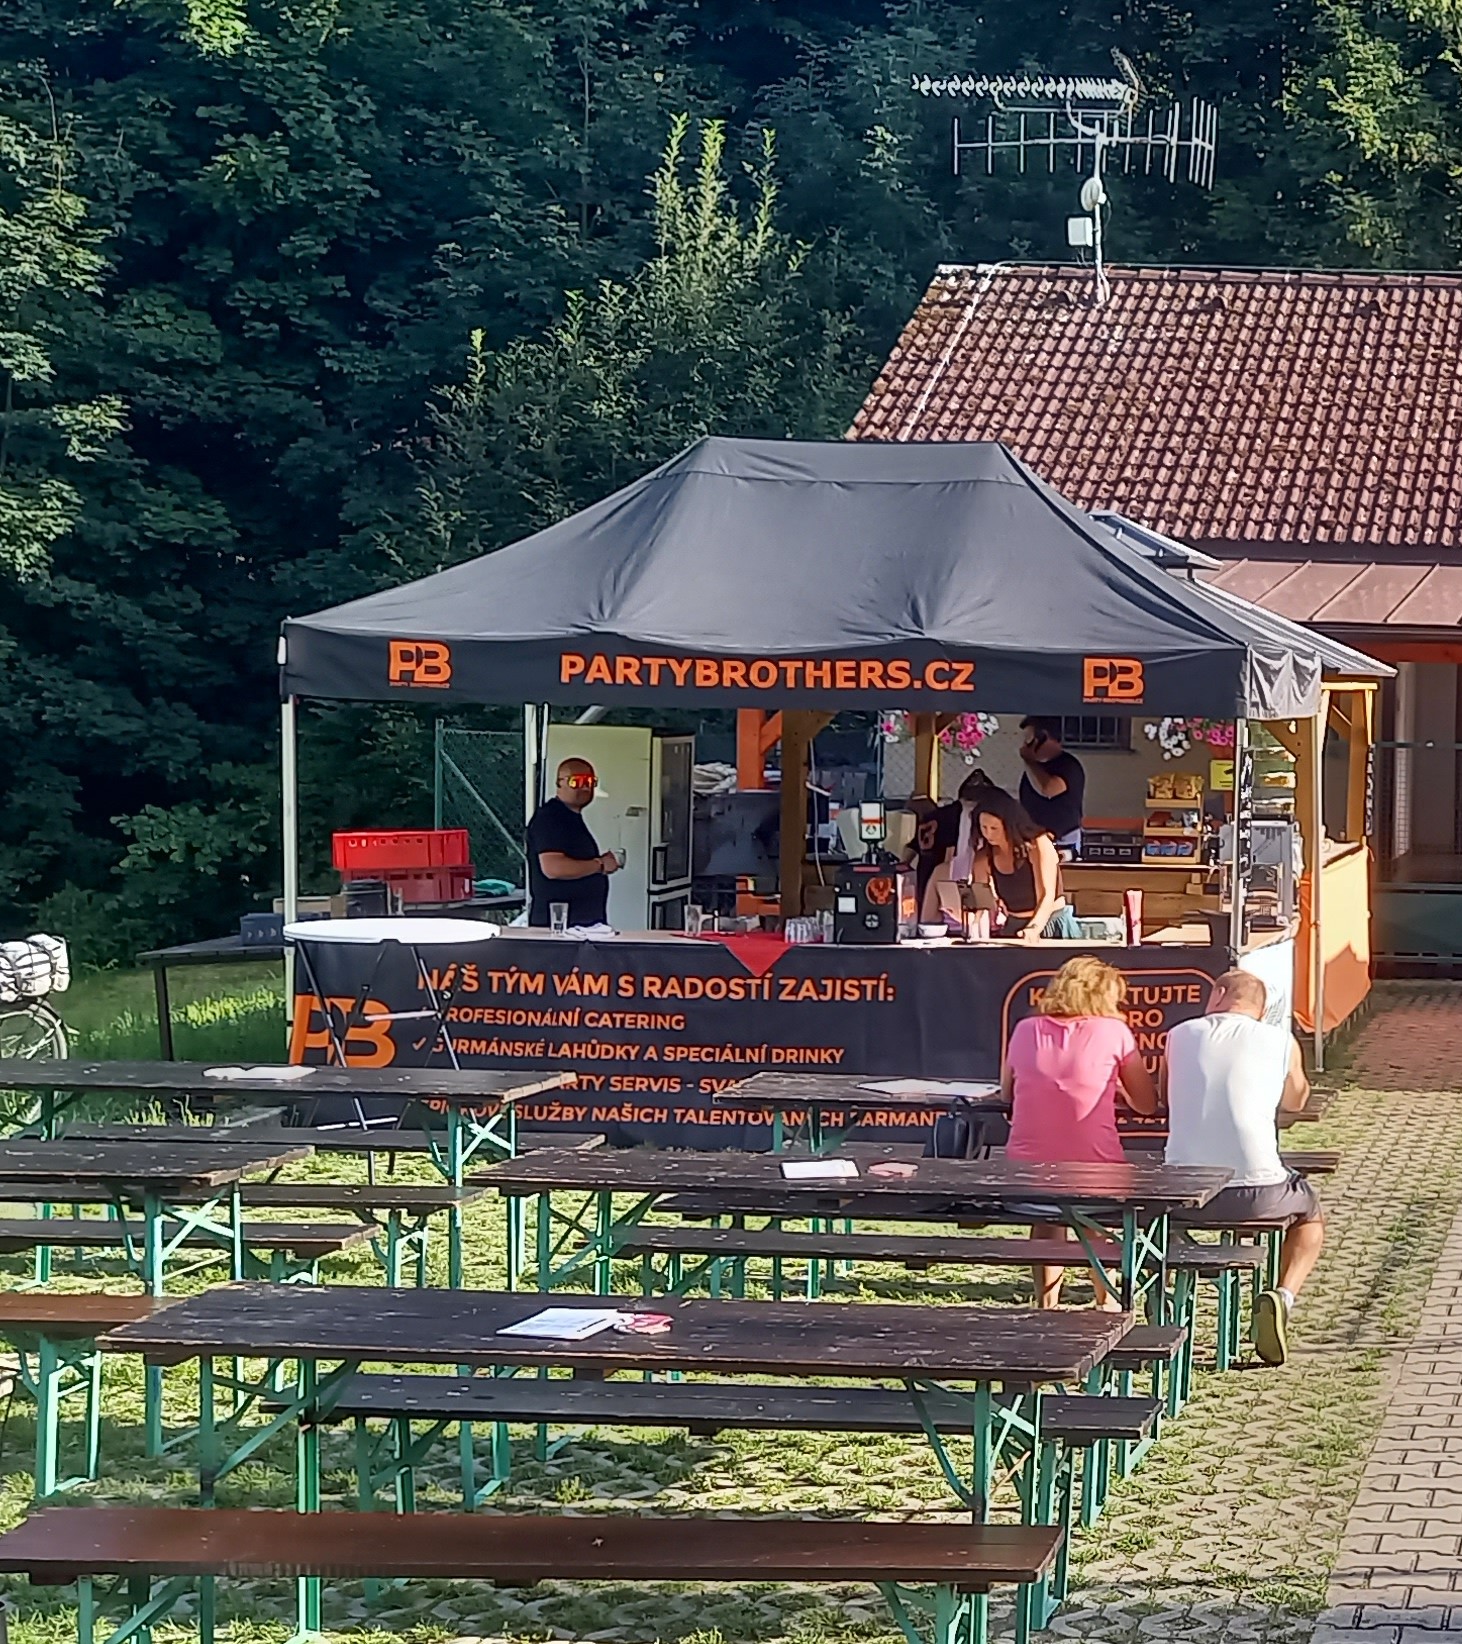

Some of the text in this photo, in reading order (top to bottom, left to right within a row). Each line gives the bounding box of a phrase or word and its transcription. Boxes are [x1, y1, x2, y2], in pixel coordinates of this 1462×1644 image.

[389, 641, 451, 682] PB
[560, 654, 975, 691] PARTYBROTHERS.CZ
[1083, 658, 1144, 698] PB
[418, 964, 895, 1001] NÁŠ TÝM VÁM S RADOSTÍ ZAJISTÍ:
[440, 1007, 685, 1030] ROFESIONÁLNÍ CATERING
[1122, 1009, 1163, 1028] RO
[549, 1039, 640, 1061] LAHŮDKY
[644, 1045, 658, 1061] A
[663, 1044, 767, 1063] SPECIÁLNÍ
[771, 1049, 844, 1064] DRINKY
[610, 1076, 681, 1093] SERVIS
[515, 1101, 586, 1122] SLUŽBY
[592, 1102, 668, 1123] NAŠICH
[674, 1107, 844, 1127] TALENTOVANCH
